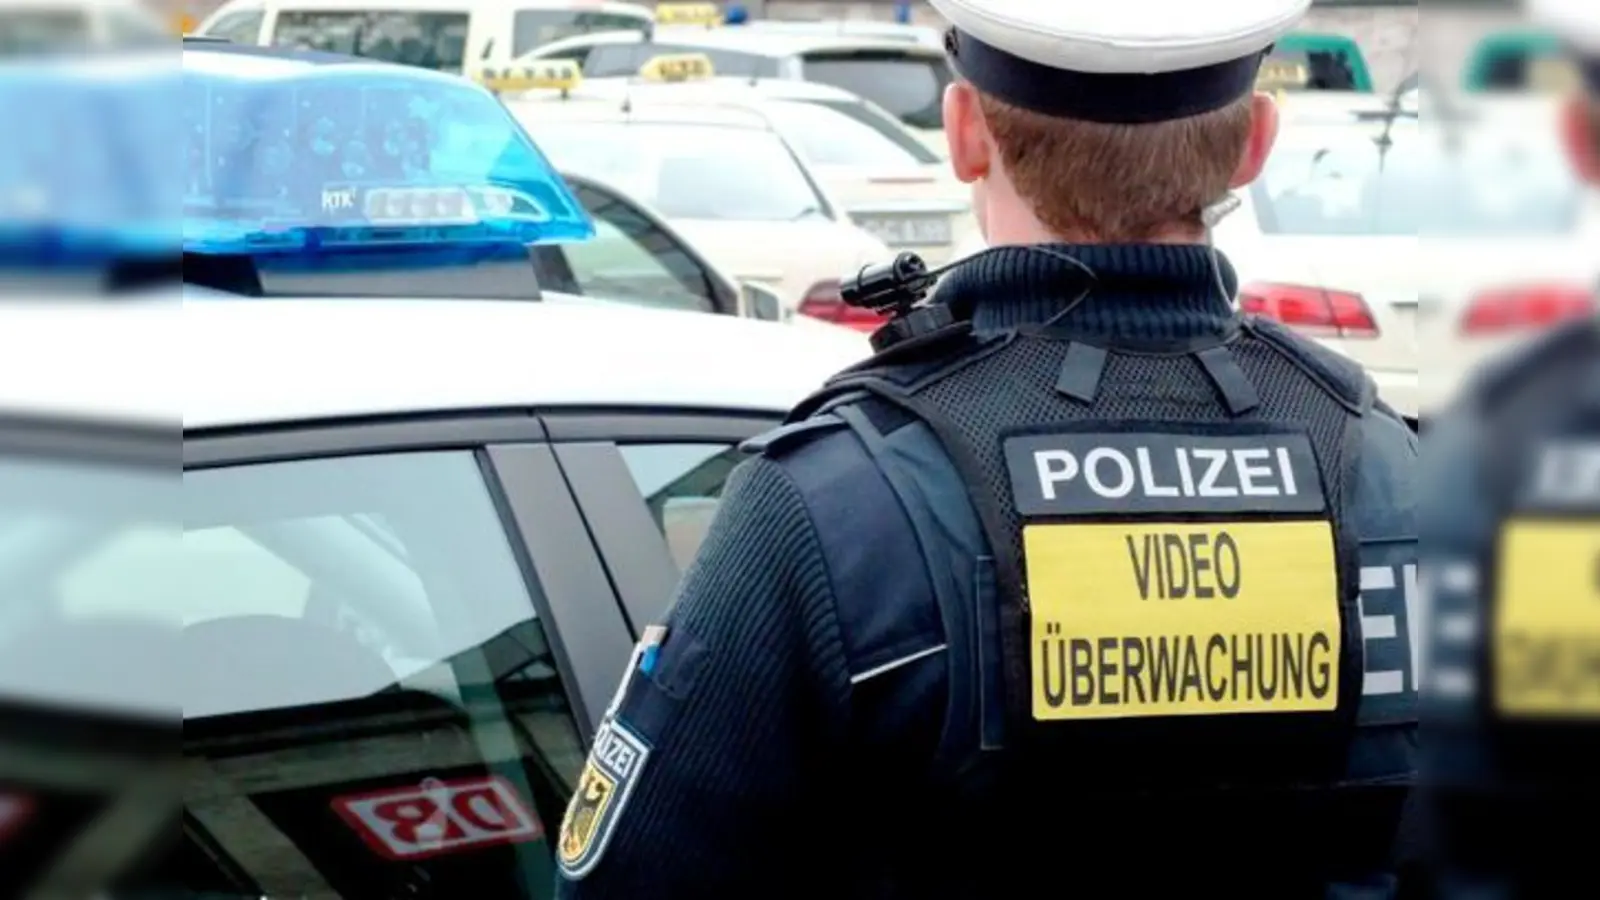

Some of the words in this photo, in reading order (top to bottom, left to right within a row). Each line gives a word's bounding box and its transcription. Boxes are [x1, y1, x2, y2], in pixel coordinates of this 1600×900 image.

[1033, 446, 1298, 500] POLIZEI
[1125, 531, 1240, 601] VIDEO
[1041, 622, 1331, 708] ÜBERWACHUNG
